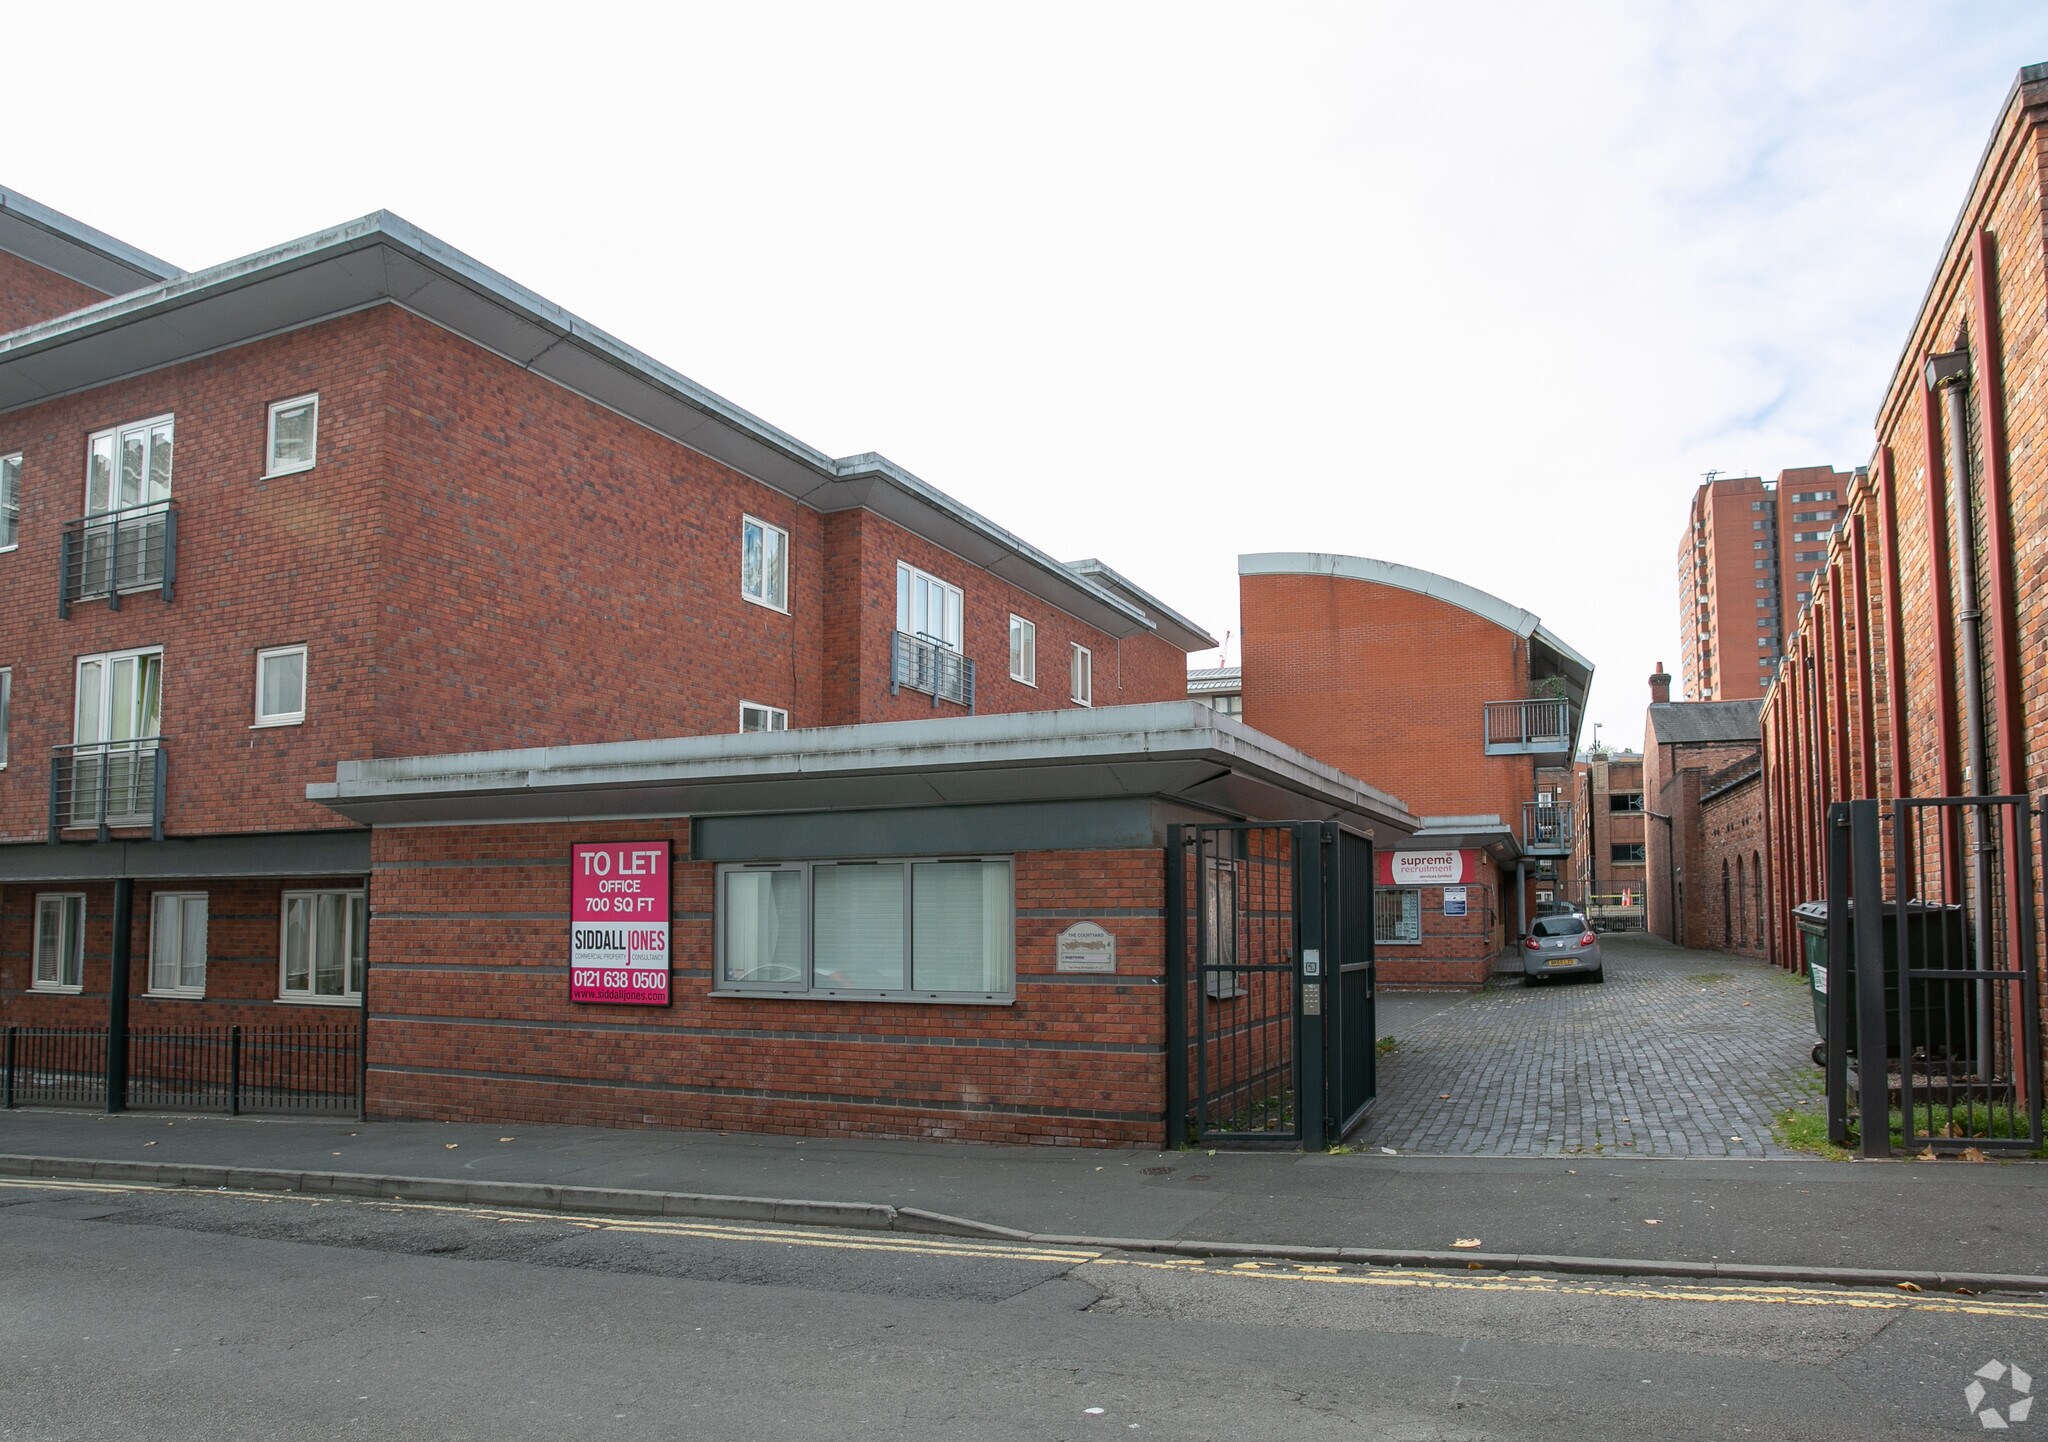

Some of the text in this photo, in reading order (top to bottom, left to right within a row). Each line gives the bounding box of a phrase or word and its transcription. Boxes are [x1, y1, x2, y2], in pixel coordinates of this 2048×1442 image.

[580, 850, 662, 876] TO LET
[1400, 856, 1453, 867] supreme
[1400, 865, 1452, 873] recruitment
[599, 880, 641, 893] OFFICE
[585, 897, 654, 912] 700 SQ FT
[575, 929, 626, 950] SIDDALL
[575, 952, 664, 961] COMMERCIAL PROPERTY CONSULTANCY
[574, 970, 666, 989] 0121 638 0500
[574, 989, 666, 1002] www.siddalljones.com
